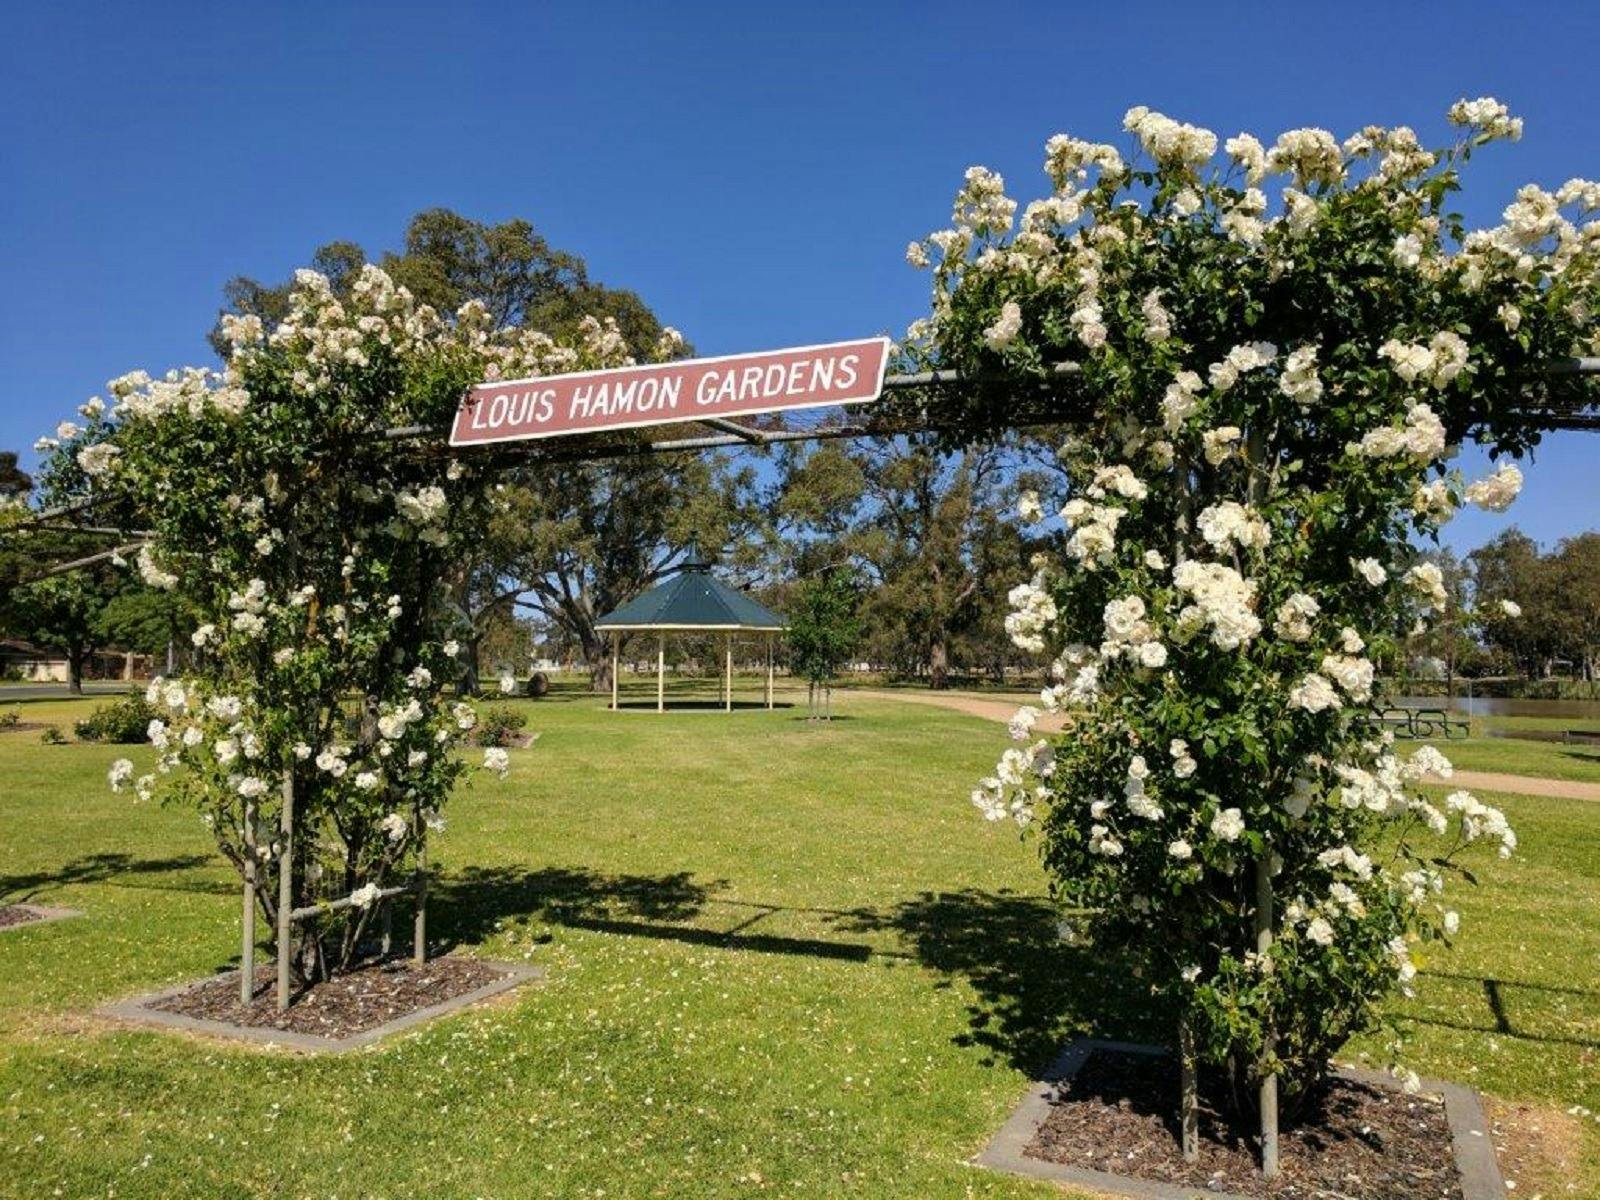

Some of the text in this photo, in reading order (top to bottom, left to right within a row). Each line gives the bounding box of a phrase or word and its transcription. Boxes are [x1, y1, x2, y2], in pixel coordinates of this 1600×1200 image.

[471, 354, 859, 430] LOUIS HAMON GARDENS
